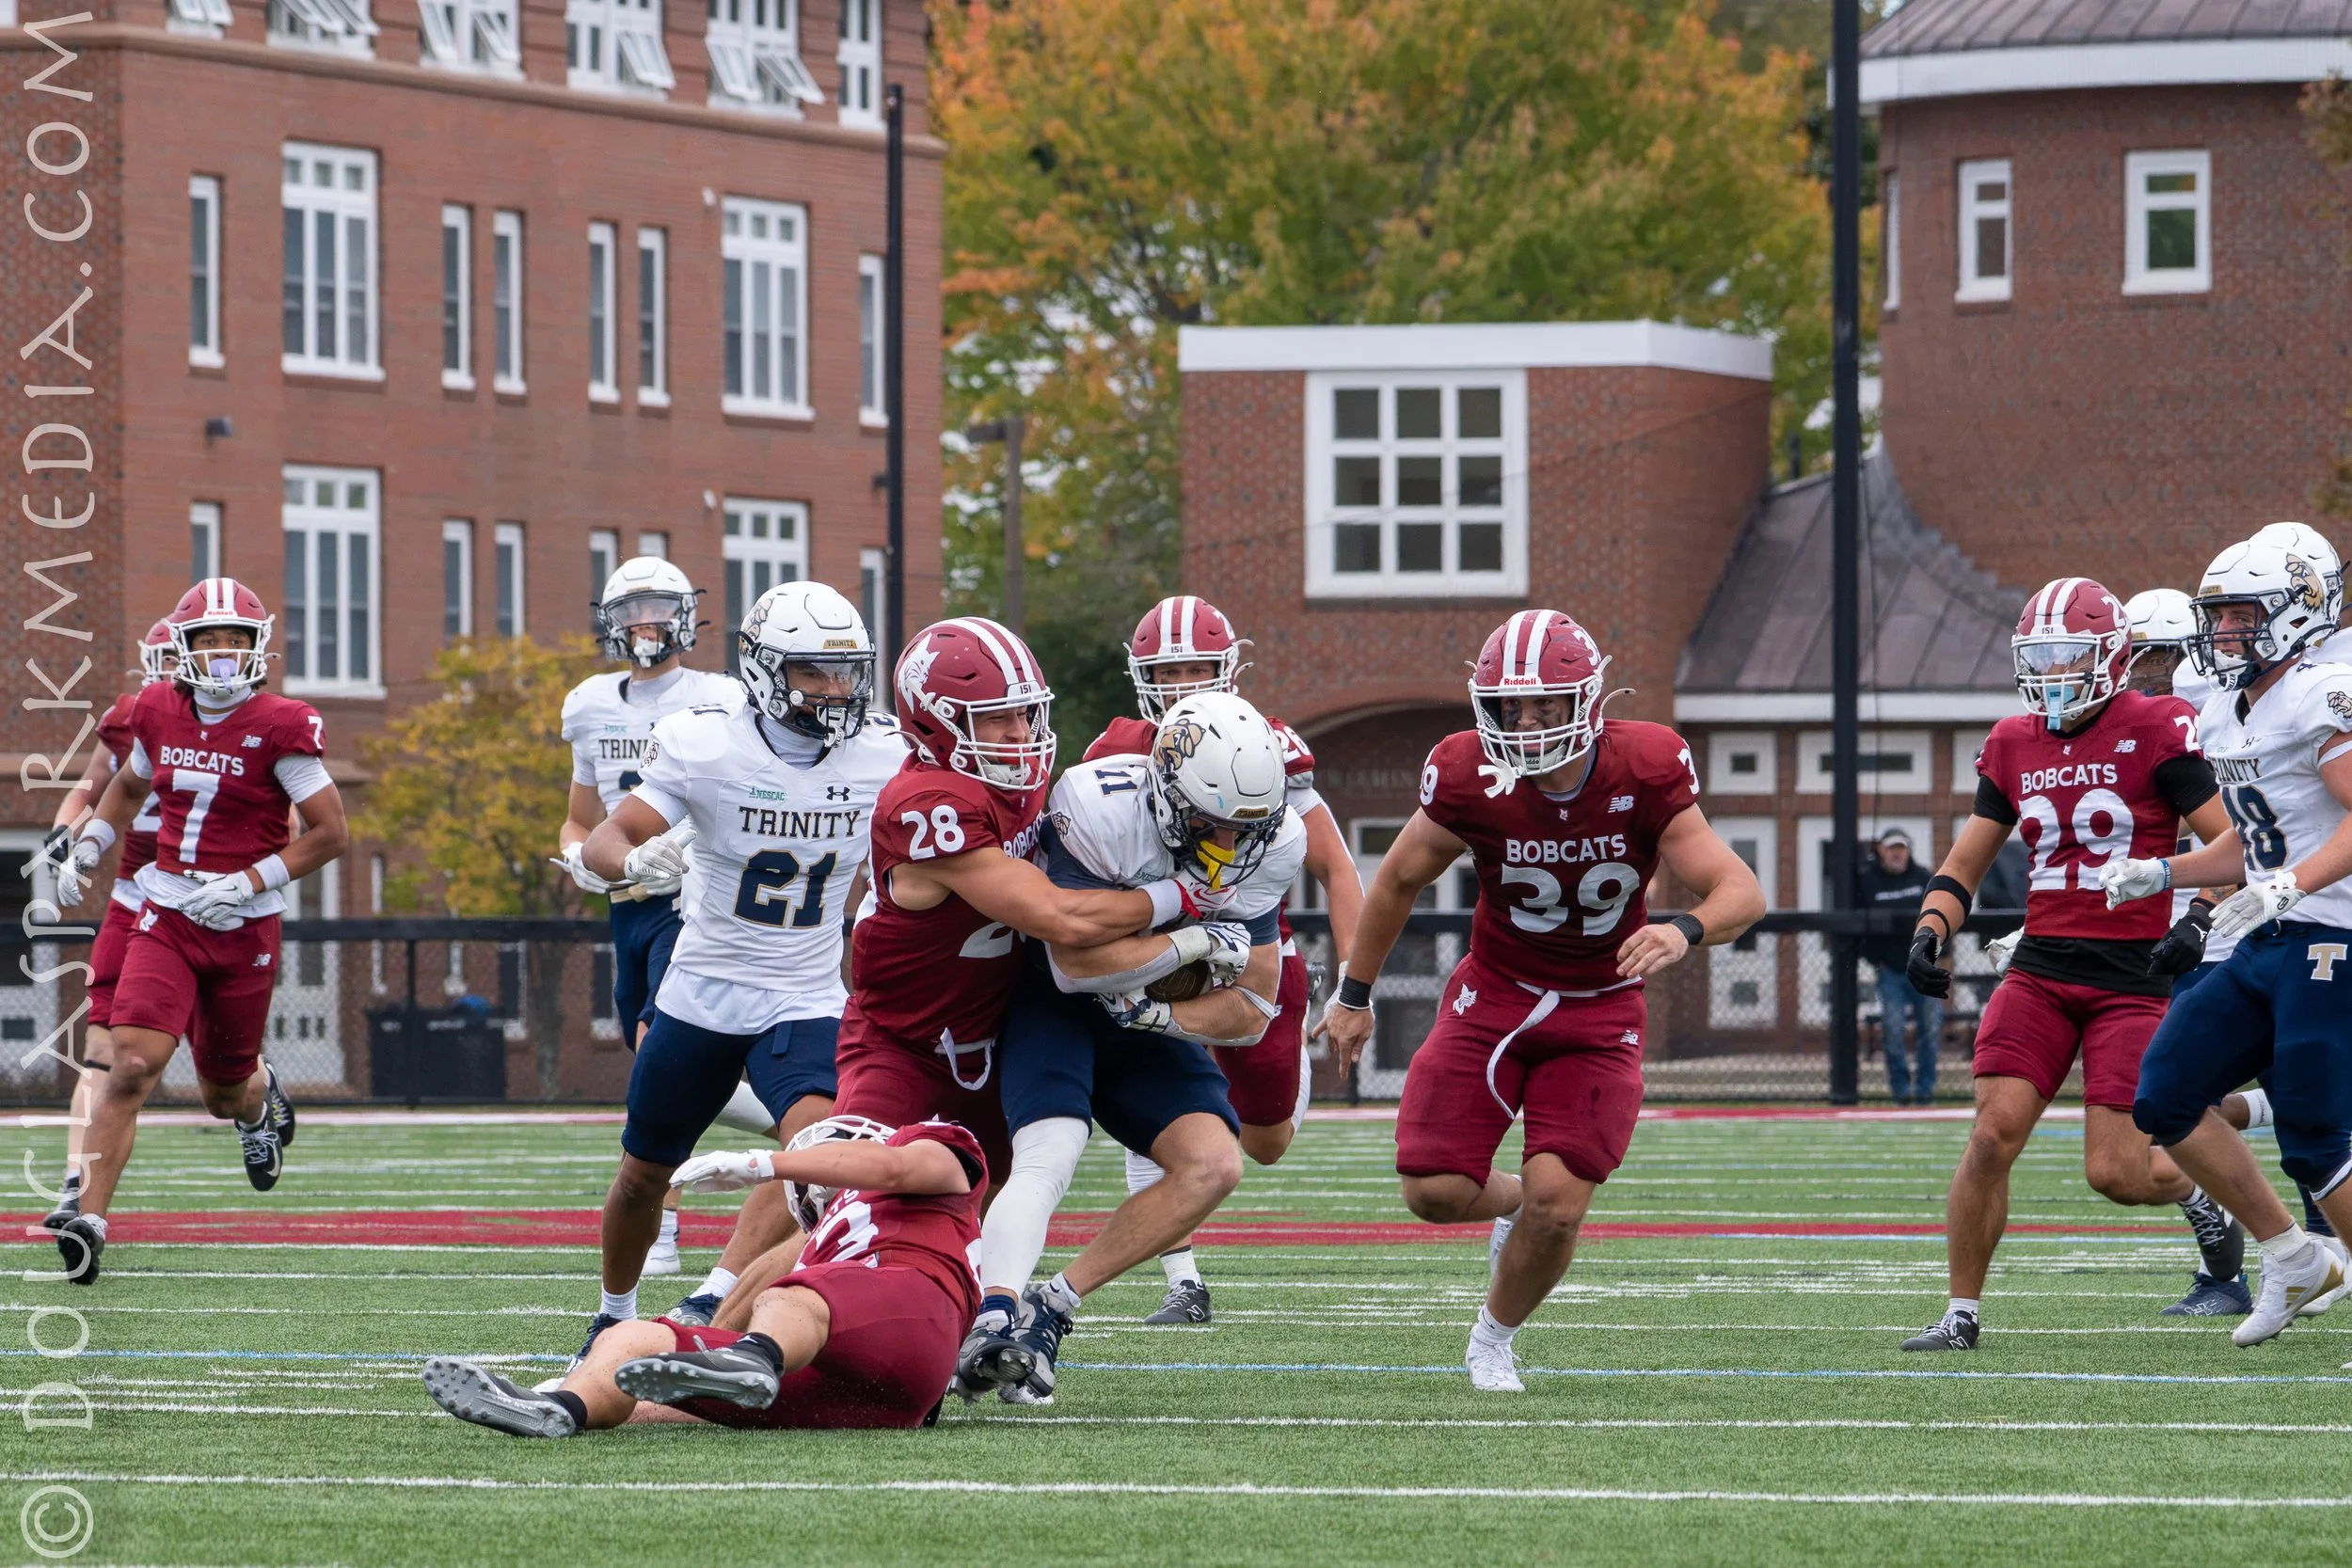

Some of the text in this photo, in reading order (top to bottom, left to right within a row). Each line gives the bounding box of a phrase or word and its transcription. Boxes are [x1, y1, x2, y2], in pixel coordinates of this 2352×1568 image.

[1020, 684, 1032, 694] 151
[307, 715, 324, 751] 7
[598, 738, 649, 759] TRIN
[2173, 715, 2202, 752] 2
[160, 745, 245, 777] BOBCATS
[2021, 763, 2118, 795] BOBCATS
[172, 768, 221, 864] 7
[739, 806, 861, 838] TRINITY
[900, 804, 965, 861] 28
[1505, 833, 1627, 863] BOBCATS
[2018, 788, 2135, 892] 29
[732, 848, 839, 929] 21
[1502, 862, 1640, 936] 39
[2307, 942, 2348, 981] T
